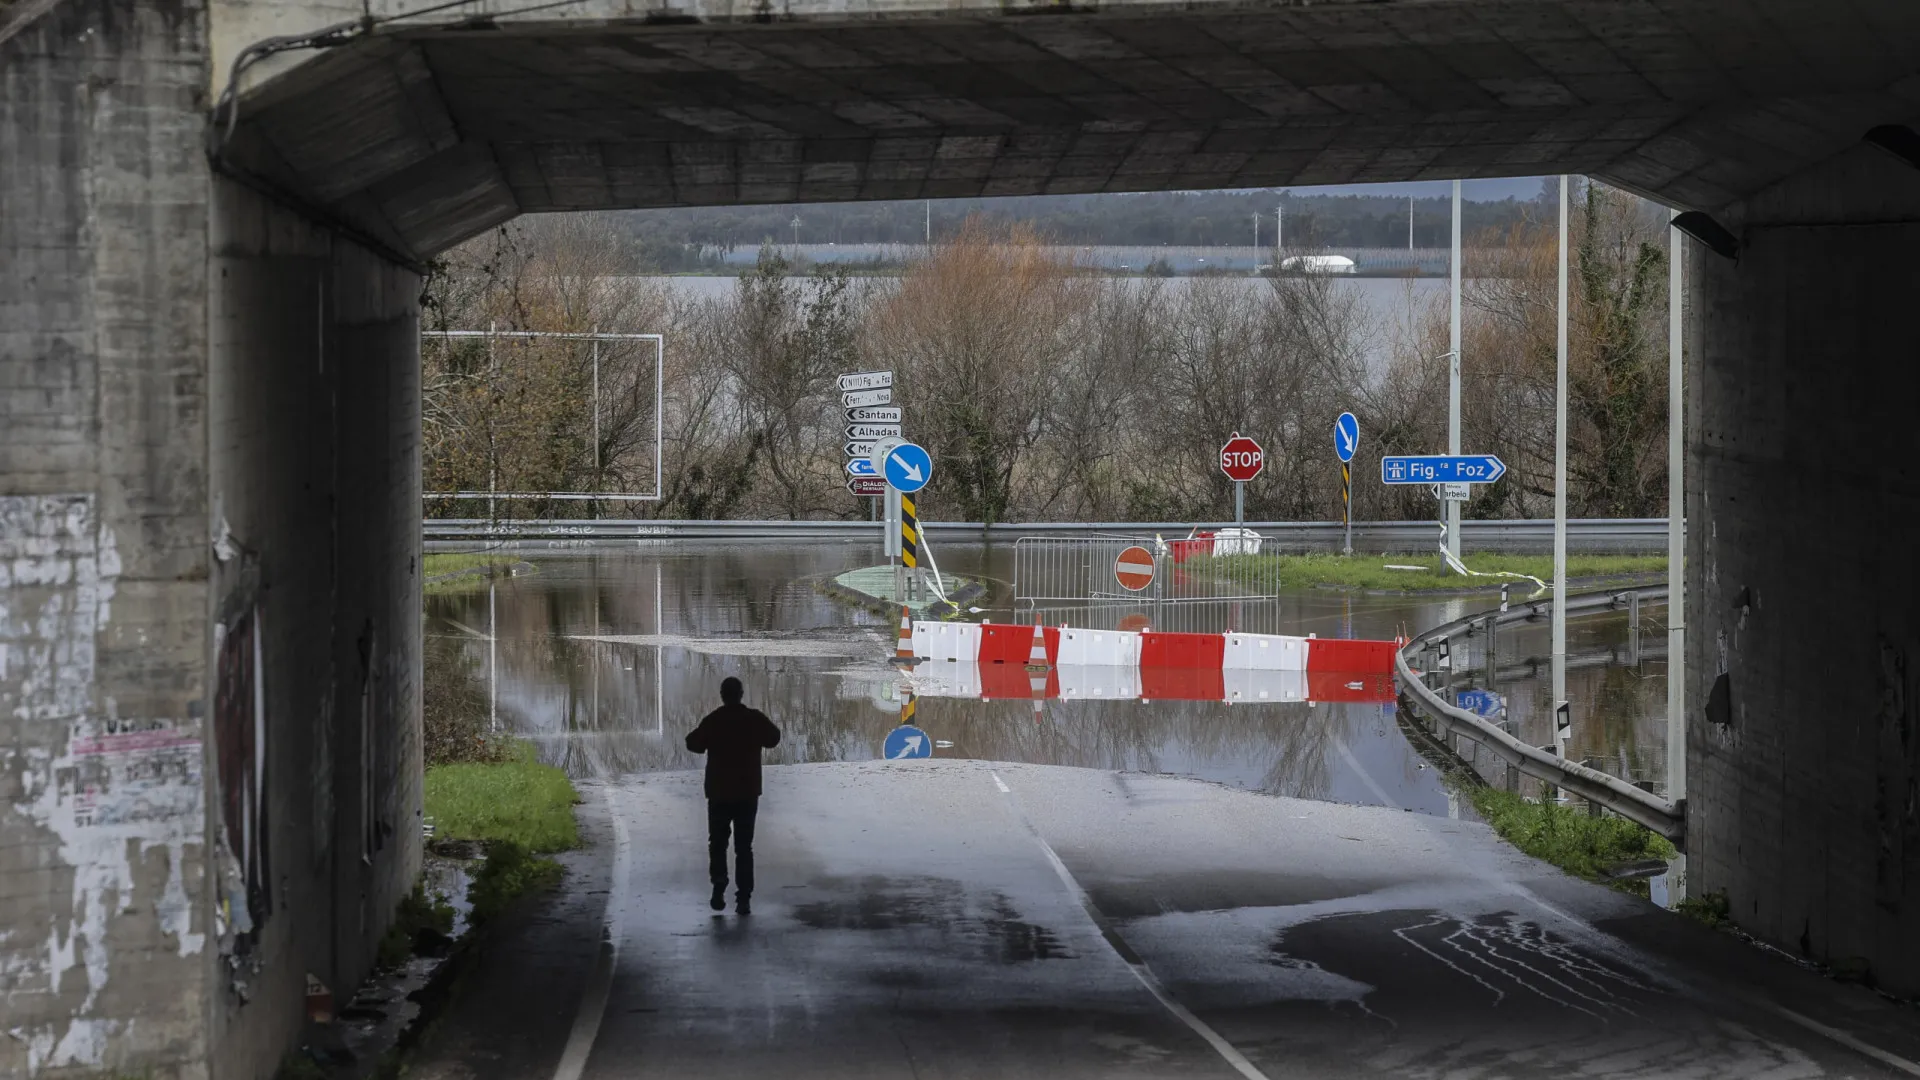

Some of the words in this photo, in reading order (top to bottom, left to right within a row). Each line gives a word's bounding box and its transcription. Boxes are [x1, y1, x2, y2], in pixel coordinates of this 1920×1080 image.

[858, 410, 898, 420] Santana
[858, 428, 898, 436] Alhadas
[858, 444, 872, 454] Ma
[1223, 451, 1261, 468] STOP
[1456, 462, 1485, 477] Foz
